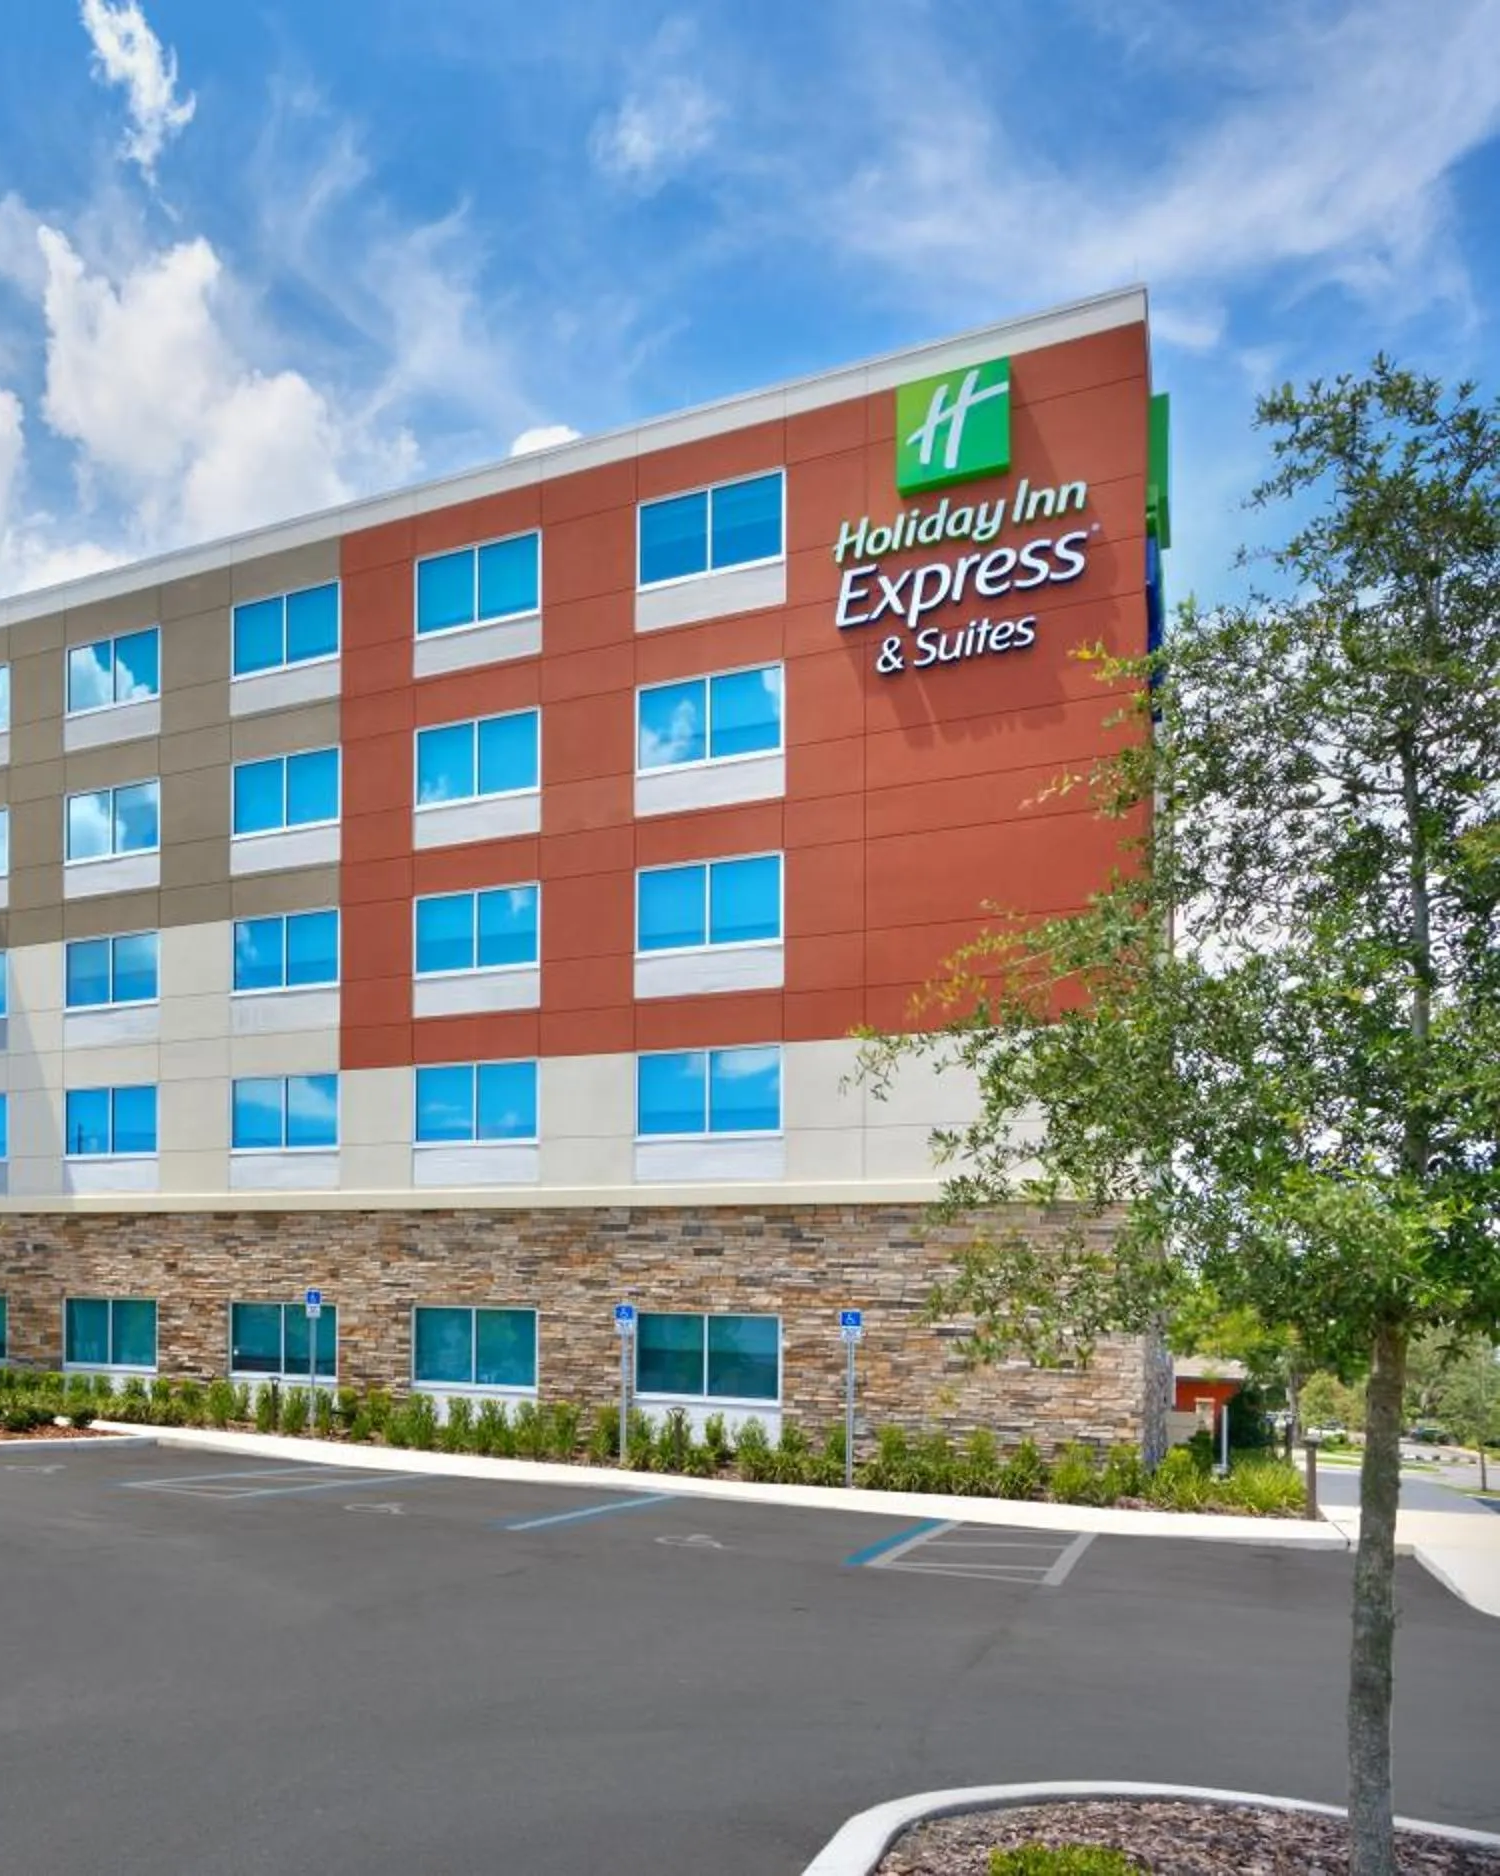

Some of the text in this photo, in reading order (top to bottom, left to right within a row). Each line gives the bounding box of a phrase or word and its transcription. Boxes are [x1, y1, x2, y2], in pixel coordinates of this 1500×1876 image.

[834, 478, 1088, 563] Holiday Inn
[835, 532, 1088, 630] Express
[876, 616, 1037, 674] & Suites
